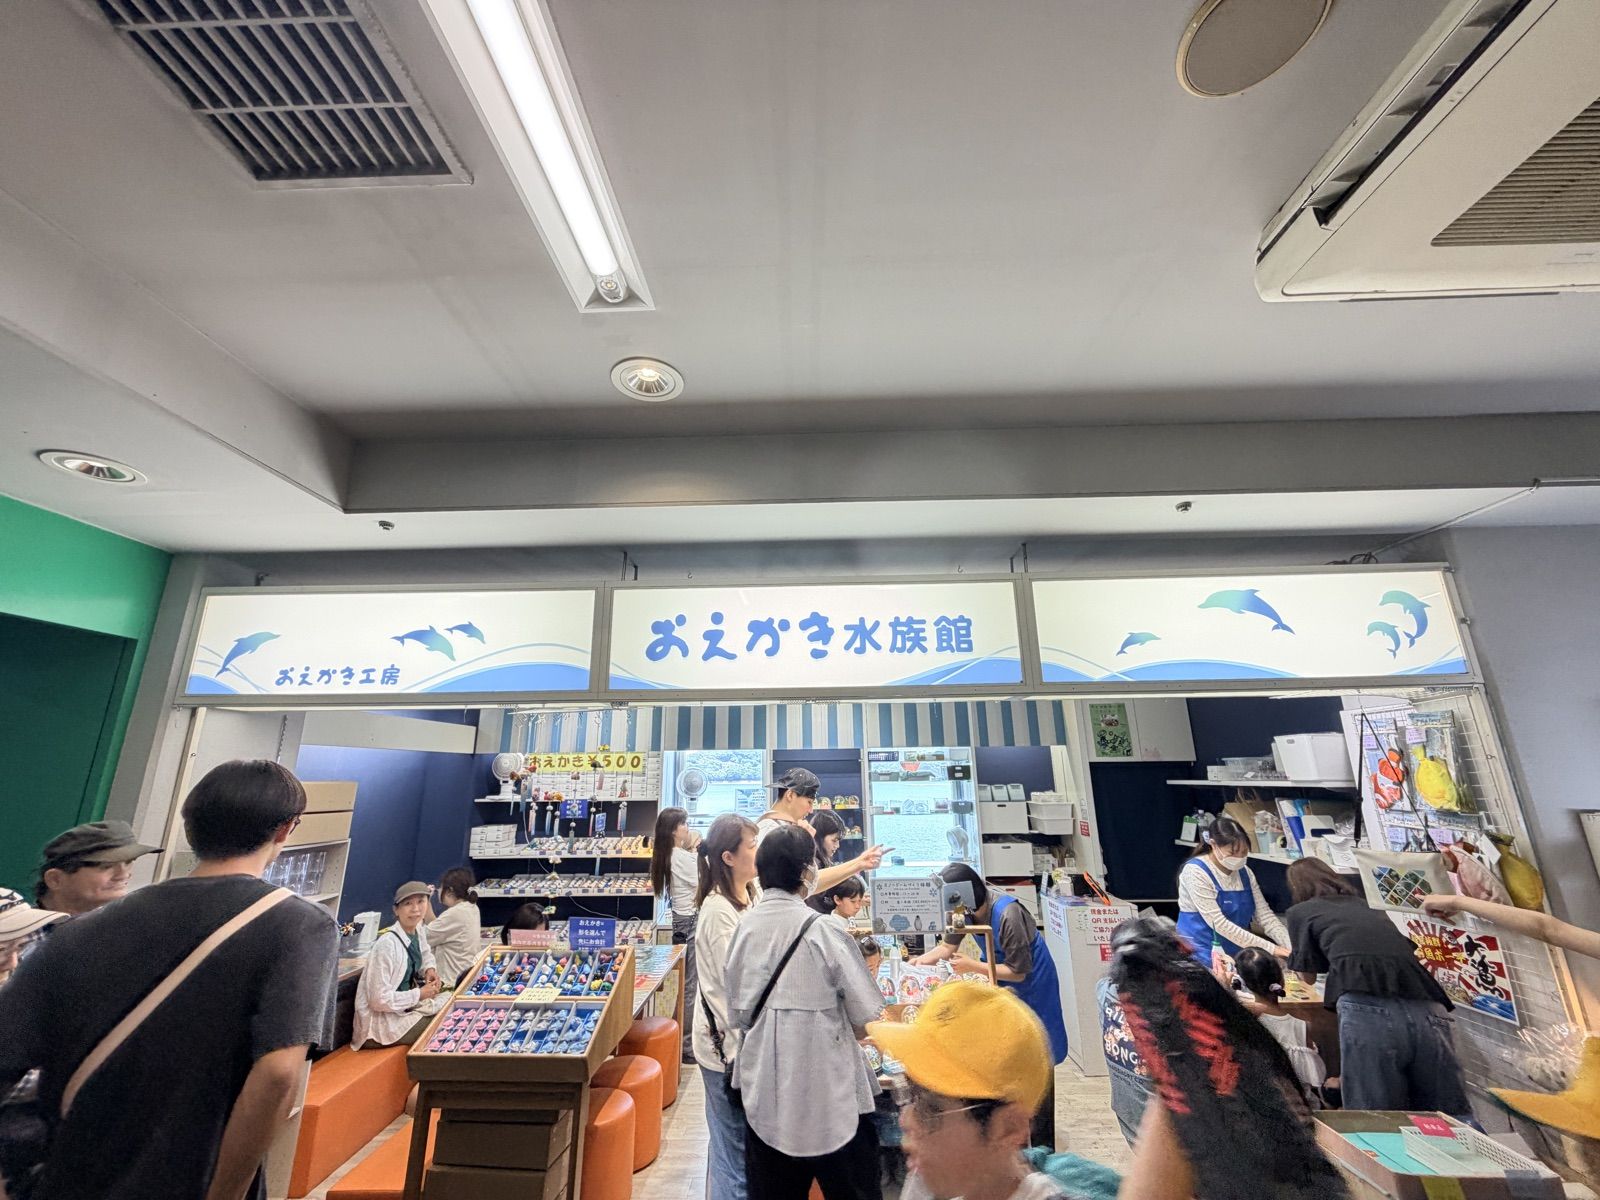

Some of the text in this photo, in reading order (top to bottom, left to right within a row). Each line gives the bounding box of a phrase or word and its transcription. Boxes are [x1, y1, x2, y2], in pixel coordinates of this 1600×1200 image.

[645, 611, 974, 662] おえかき水族館
[274, 663, 401, 687] おえかき工房
